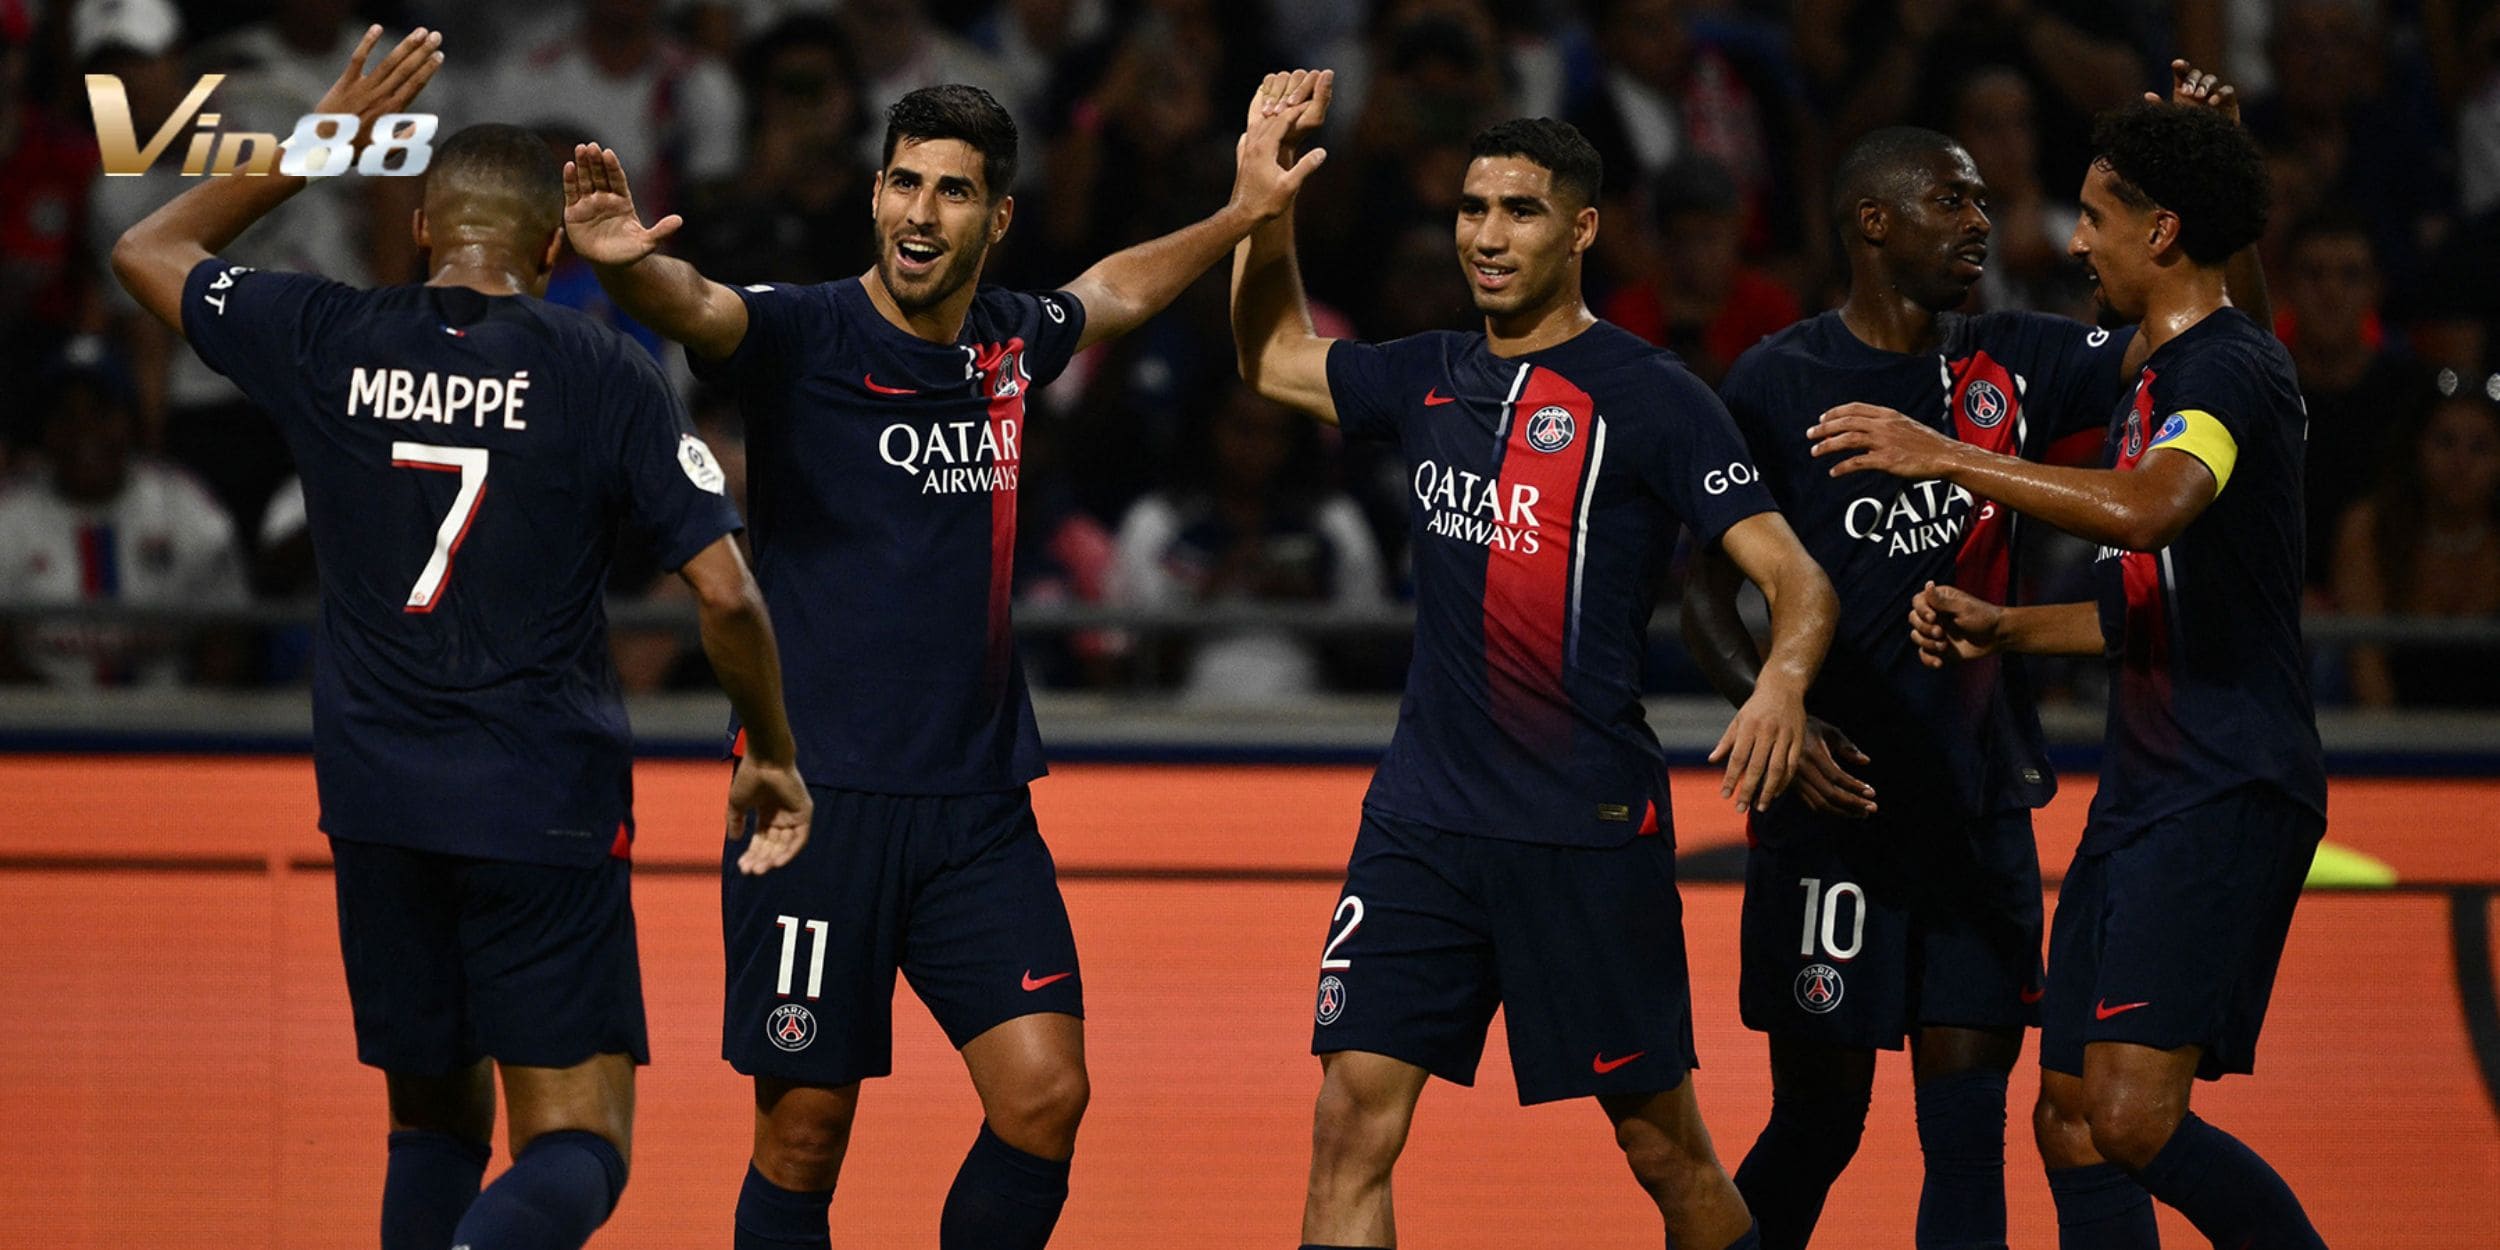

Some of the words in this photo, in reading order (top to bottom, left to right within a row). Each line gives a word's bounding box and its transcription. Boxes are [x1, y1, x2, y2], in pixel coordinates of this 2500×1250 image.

[347, 367, 530, 430] MBAPPÉ
[878, 418, 1019, 476] QATAR
[921, 464, 1018, 494] AIRWAYS
[1414, 460, 1540, 527] QATAR
[391, 441, 489, 613] 7
[1427, 509, 1540, 555] AIRWAYS
[1844, 479, 1976, 543] QATA
[1320, 895, 1364, 973] 2
[1799, 877, 1867, 963] 10
[776, 914, 829, 1003] 11
[1803, 966, 1836, 981] PARIS
[775, 1006, 809, 1021] PARIS
